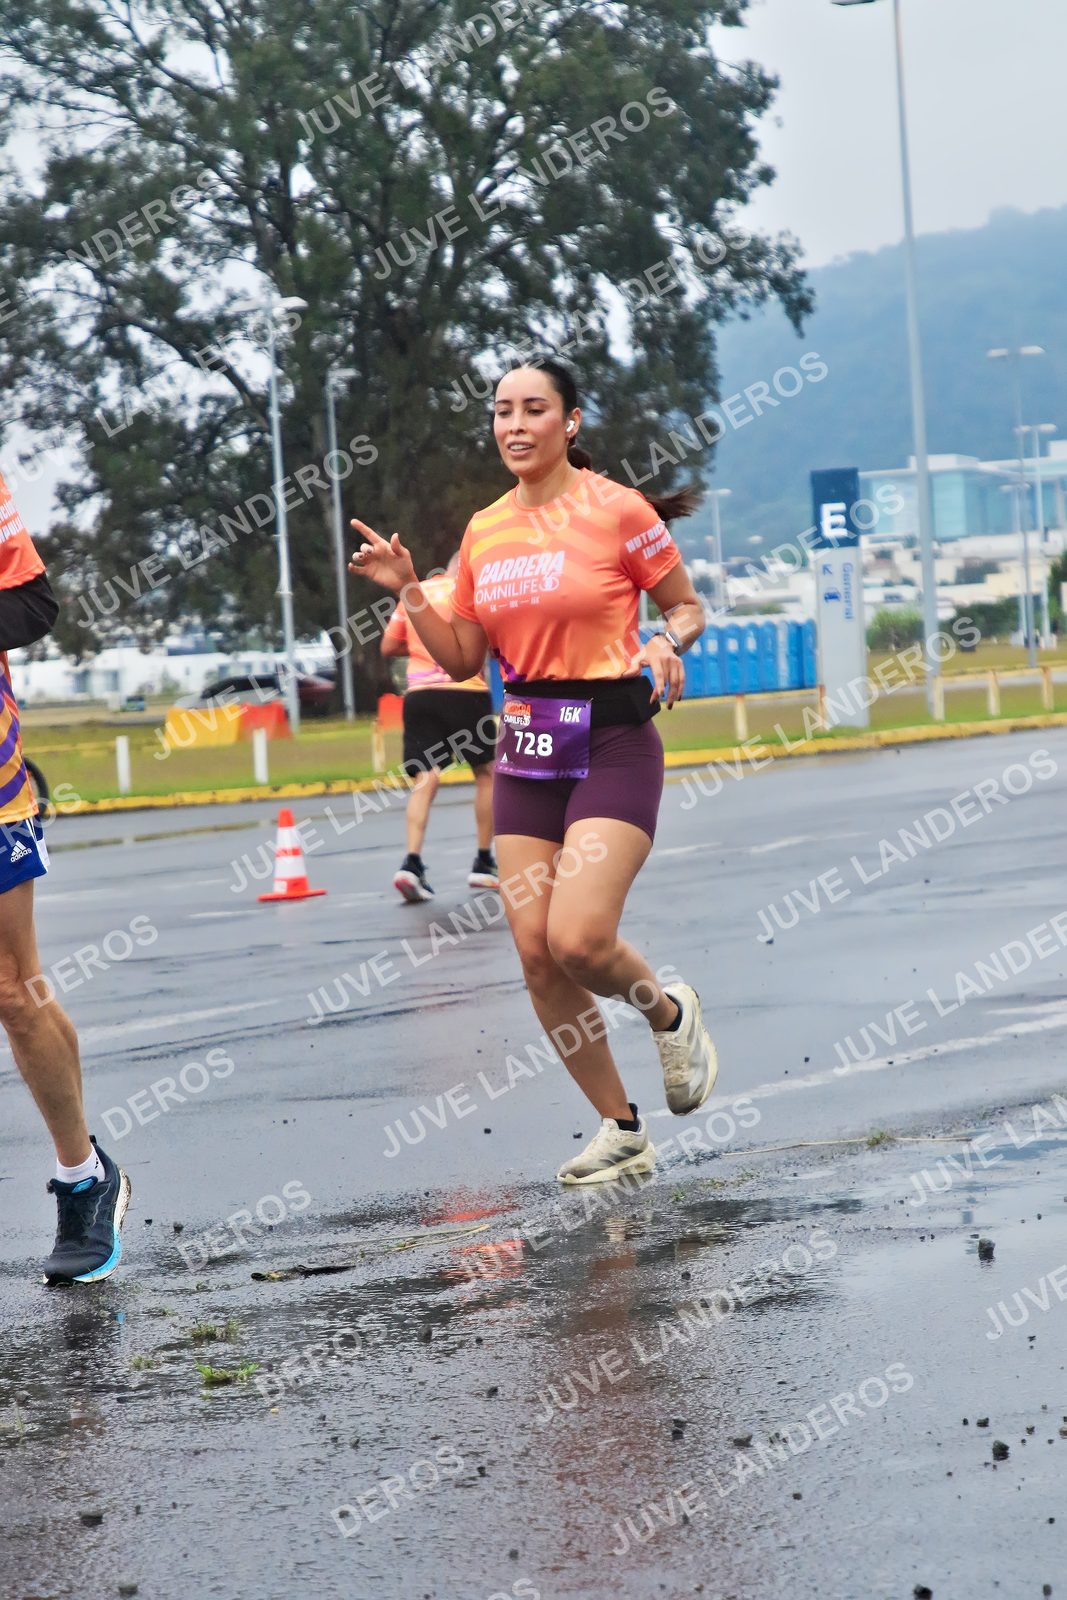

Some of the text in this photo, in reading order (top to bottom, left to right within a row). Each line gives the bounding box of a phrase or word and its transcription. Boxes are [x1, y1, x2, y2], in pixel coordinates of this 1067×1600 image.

[820, 502, 848, 538] E
[477, 550, 566, 587] CARRERA
[475, 578, 539, 604] OMNILIFE
[514, 730, 553, 757] 728
[10, 847, 33, 863] adidas
